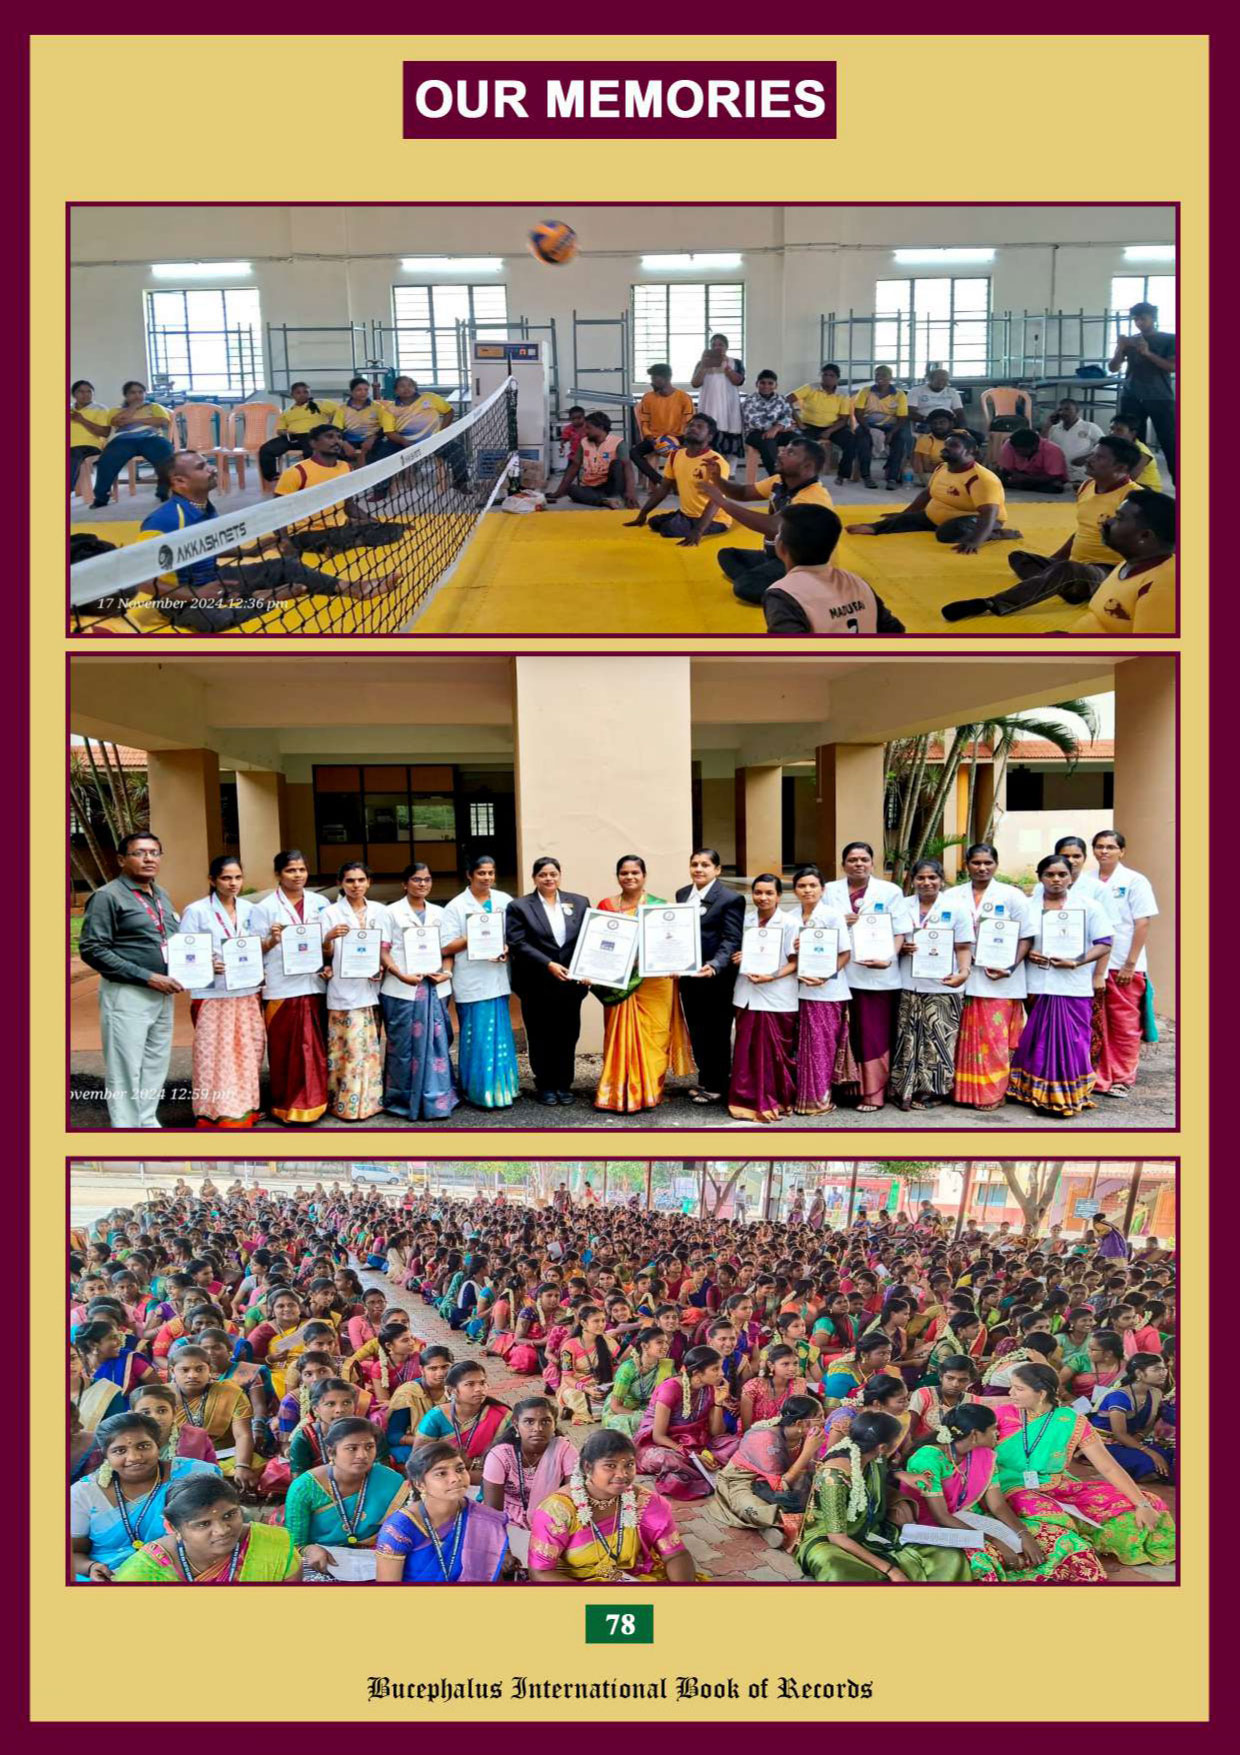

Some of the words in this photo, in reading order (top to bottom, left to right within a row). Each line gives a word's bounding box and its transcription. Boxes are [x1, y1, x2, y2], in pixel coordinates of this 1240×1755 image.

[415, 79, 529, 118] OUR
[547, 79, 826, 118] MEMORIES
[605, 1613, 636, 1635] 78
[367, 1676, 503, 1703] Bucephalus
[511, 1676, 668, 1700] International
[675, 1676, 740, 1702] Book
[748, 1677, 769, 1700] of
[777, 1676, 874, 1700] Records
